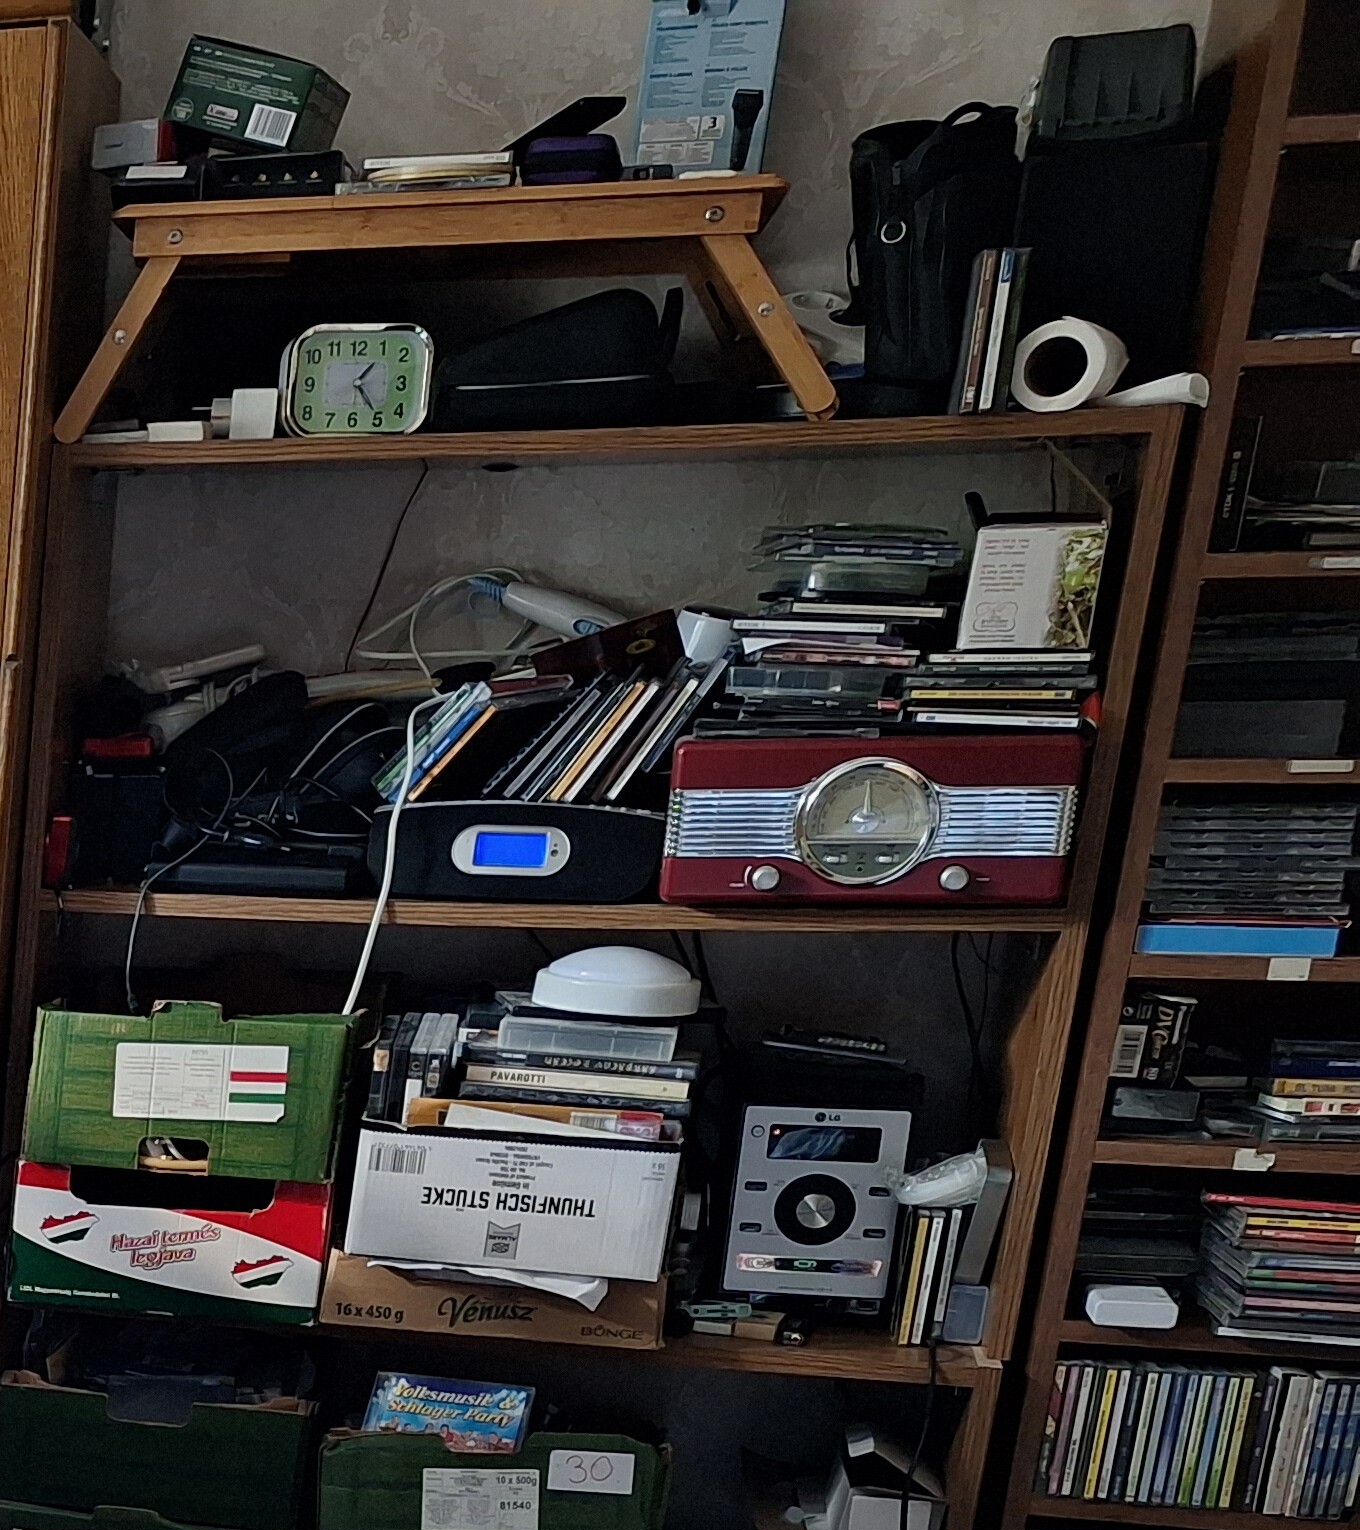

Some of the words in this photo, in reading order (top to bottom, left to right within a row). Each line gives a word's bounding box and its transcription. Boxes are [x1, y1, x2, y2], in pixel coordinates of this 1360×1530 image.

[709, 116, 717, 129] 3
[328, 340, 341, 357] 11
[350, 340, 368, 356] 12
[379, 339, 387, 356] 1
[398, 347, 409, 363] 2
[305, 348, 321, 365] 10
[304, 376, 315, 393] 9
[395, 375, 407, 391] 3
[302, 405, 312, 421] 8
[393, 402, 404, 419] 4
[325, 412, 336, 428] 7
[347, 412, 358, 428] 6
[371, 411, 383, 428] 5
[490, 1070, 546, 1085] PAVAROTTI
[828, 1113, 841, 1122] LG
[420, 1186, 490, 1212] STÜCKE
[495, 1191, 597, 1218] THUNFISCH
[110, 1230, 159, 1253] Hazai
[161, 1222, 221, 1245] termés
[130, 1246, 197, 1271] legjava
[335, 1302, 352, 1317] 16
[353, 1306, 363, 1317] x
[365, 1305, 392, 1320] 450
[393, 1310, 405, 1324] g
[437, 1294, 538, 1328] Vénusz
[393, 1384, 495, 1407] Volksmusik
[497, 1392, 520, 1411] &
[386, 1399, 463, 1421] Schlager
[463, 1406, 516, 1428] Party
[565, 1455, 614, 1484] 30
[495, 1476, 506, 1484] 10
[499, 1501, 532, 1511] 81540
